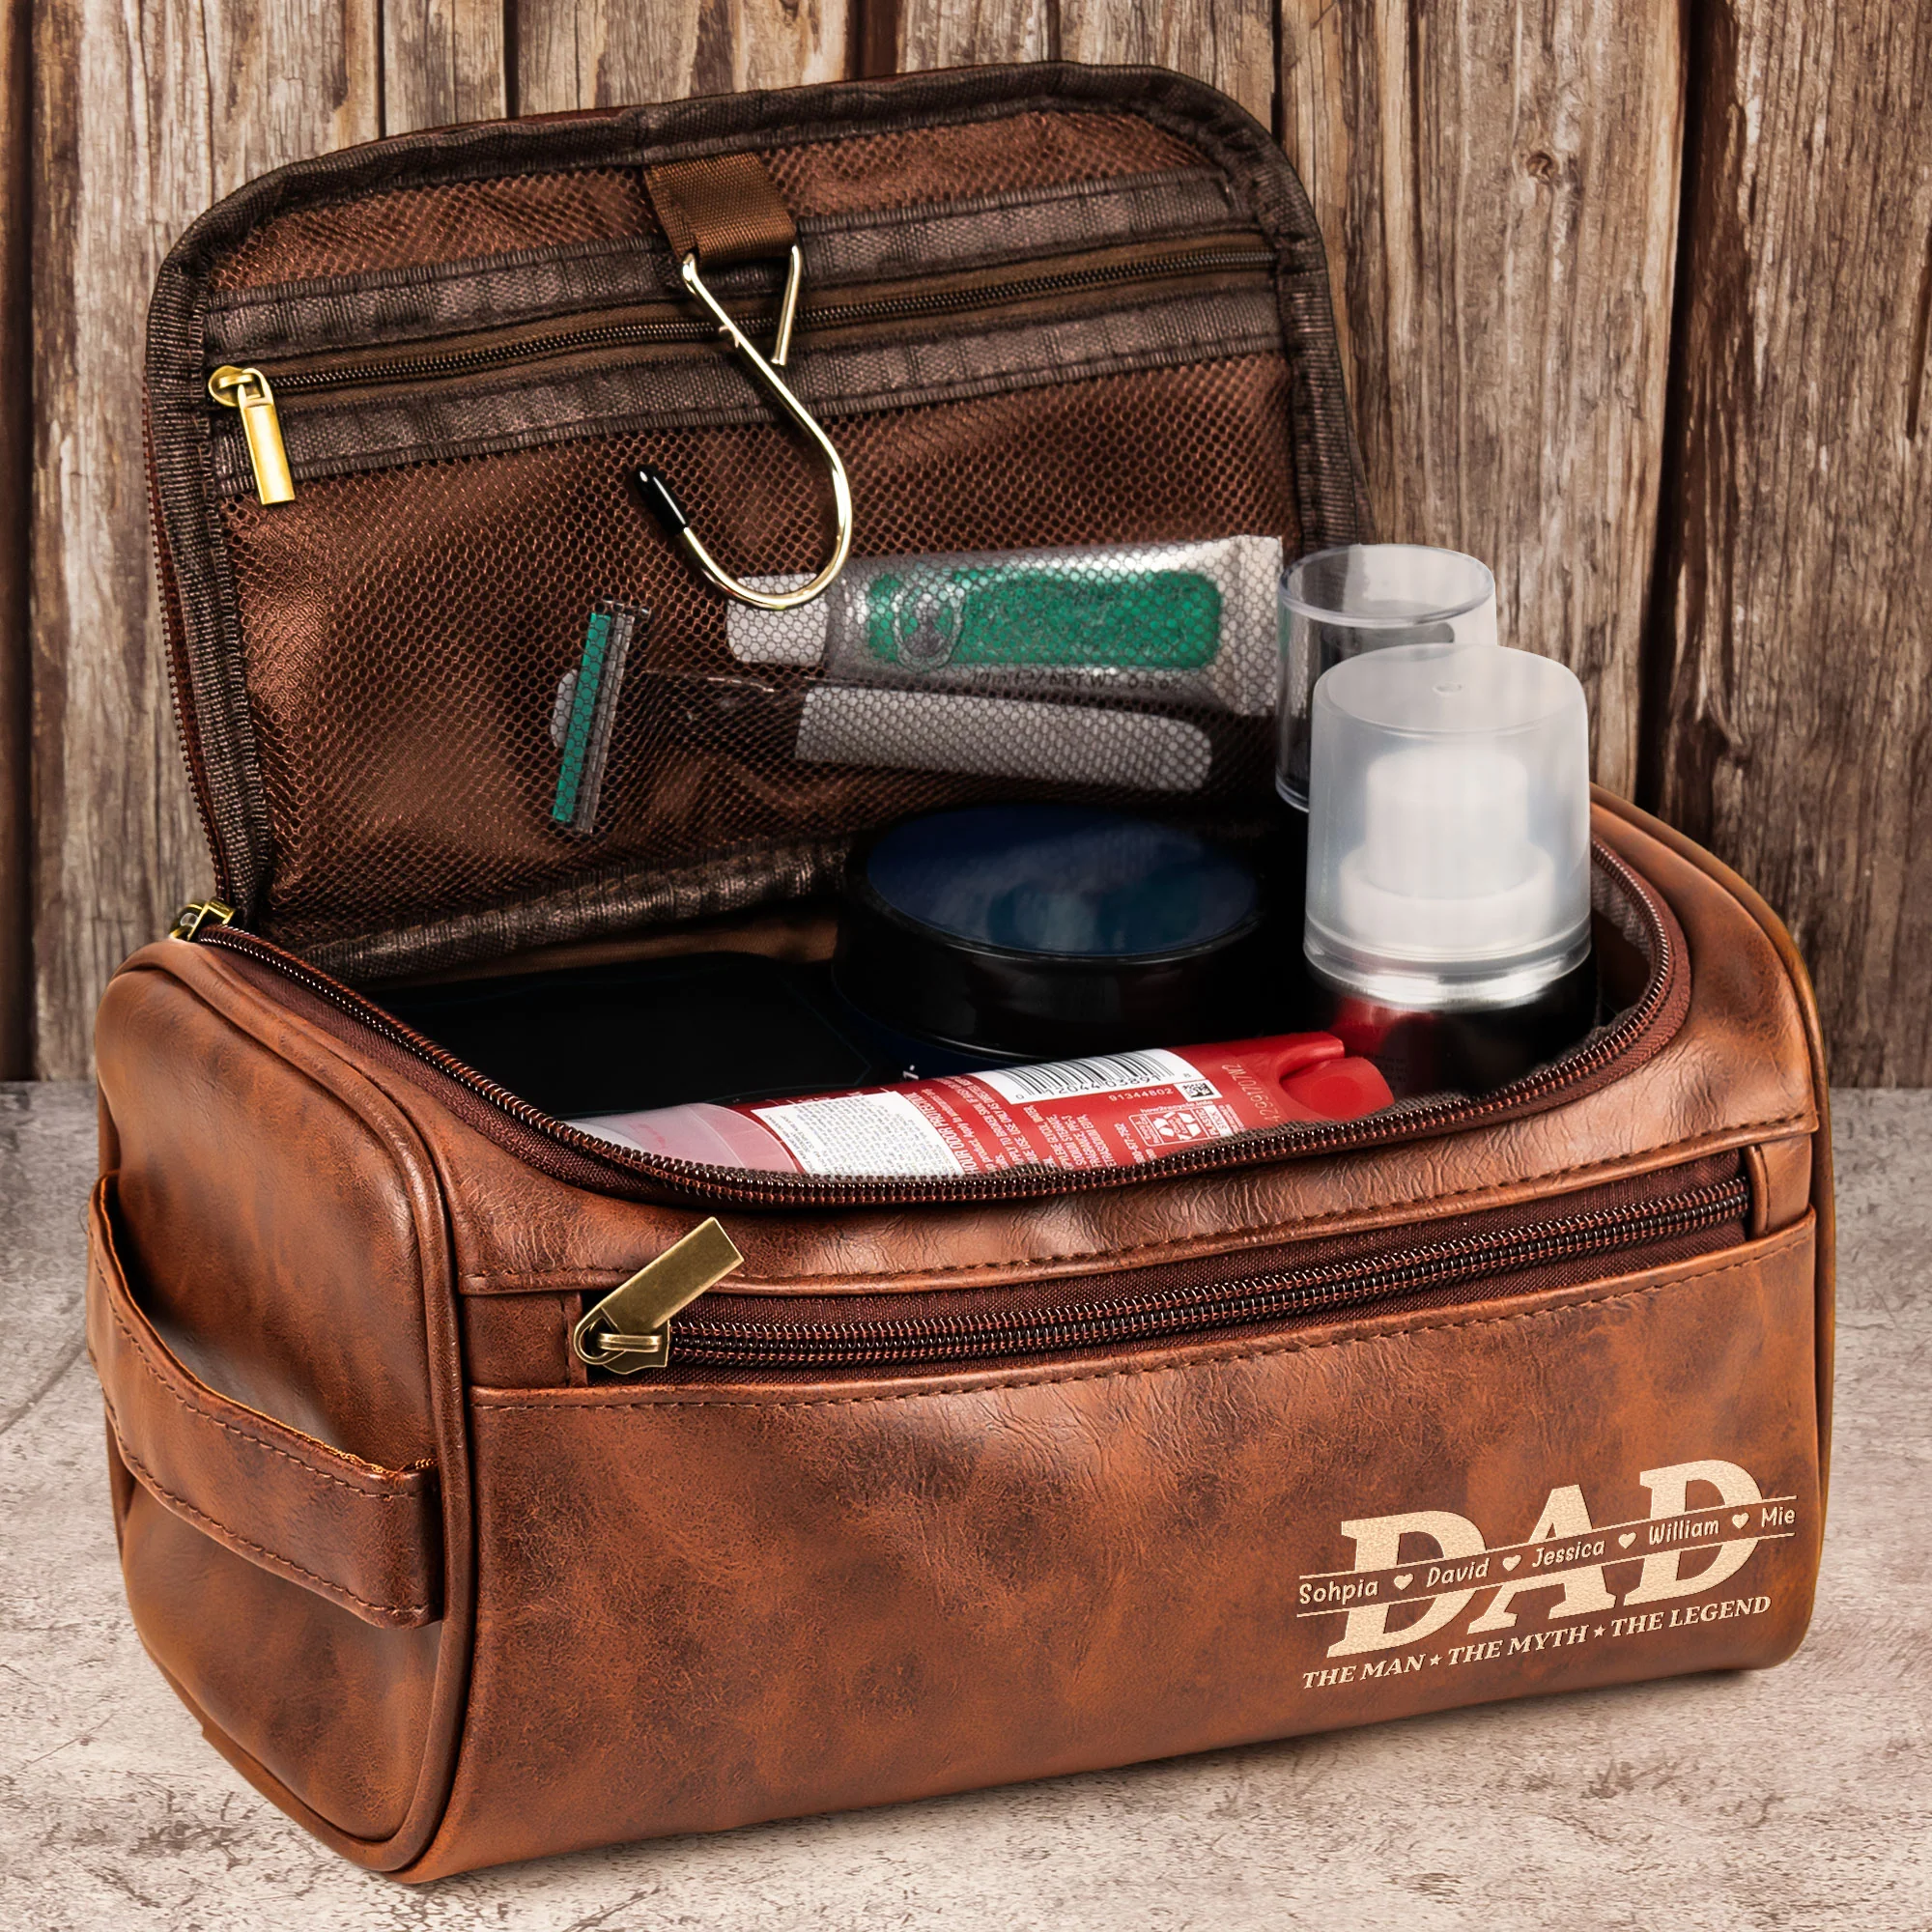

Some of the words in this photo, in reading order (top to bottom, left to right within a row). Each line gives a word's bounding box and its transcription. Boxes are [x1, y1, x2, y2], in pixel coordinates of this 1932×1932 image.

[1045, 1078, 1101, 1097] 12044
[1109, 1074, 1162, 1088] 03891
[1108, 1088, 1174, 1101] 91344802
[982, 1115, 1008, 1138] BROKEN
[992, 1110, 1012, 1123] ONLY
[1195, 1108, 1219, 1136] PLASTIC
[938, 1126, 964, 1150] ODOR
[956, 1122, 976, 1138] Apply
[1004, 1122, 1021, 1135] USE
[999, 1137, 1013, 1147] TO
[954, 1149, 981, 1175] HOUR
[1064, 1142, 1088, 1166] SODIUM
[1298, 1578, 1379, 1605] Sohpia
[1426, 1557, 1491, 1588] David
[1531, 1539, 1606, 1568] Jessica
[1648, 1518, 1720, 1546] William
[1760, 1506, 1796, 1528] Mie
[1326, 1459, 1763, 1658] DAD
[1302, 1664, 1357, 1690] THE
[1359, 1653, 1427, 1681] MAN
[1448, 1639, 1503, 1665] THE
[1507, 1625, 1590, 1656] MYTH
[1610, 1612, 1664, 1637] THE
[1668, 1596, 1773, 1628] LEGEND
